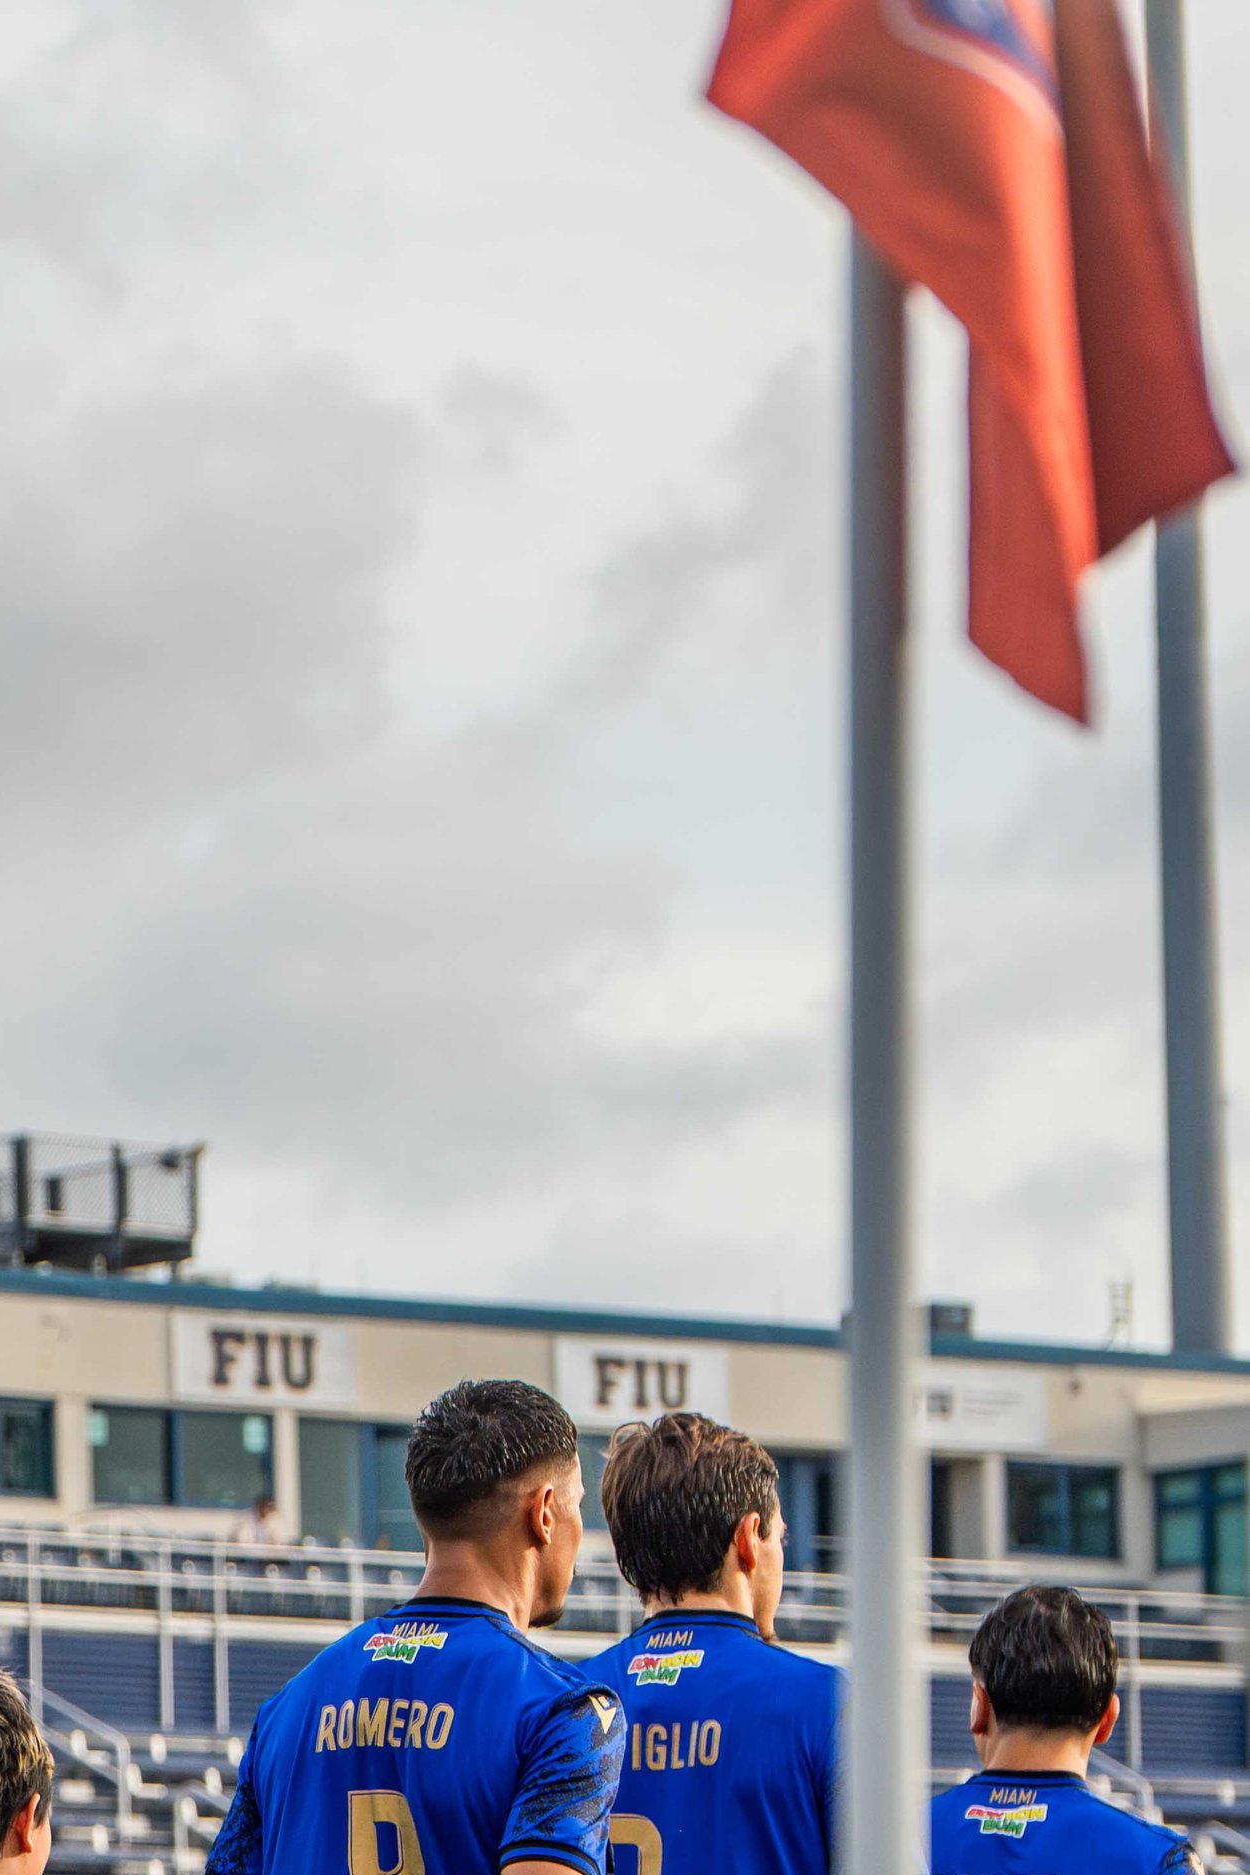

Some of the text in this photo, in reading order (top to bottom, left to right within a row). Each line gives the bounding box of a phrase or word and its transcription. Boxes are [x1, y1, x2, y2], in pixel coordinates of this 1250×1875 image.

[210, 1330, 316, 1391] FIU
[594, 1357, 689, 1408] FIU
[391, 1621, 439, 1638] MIAMI
[646, 1630, 694, 1649] MIAMI
[315, 1696, 455, 1753] ROMERO
[631, 1718, 722, 1772] IGLIO
[989, 1786, 1038, 1805] MIAMI
